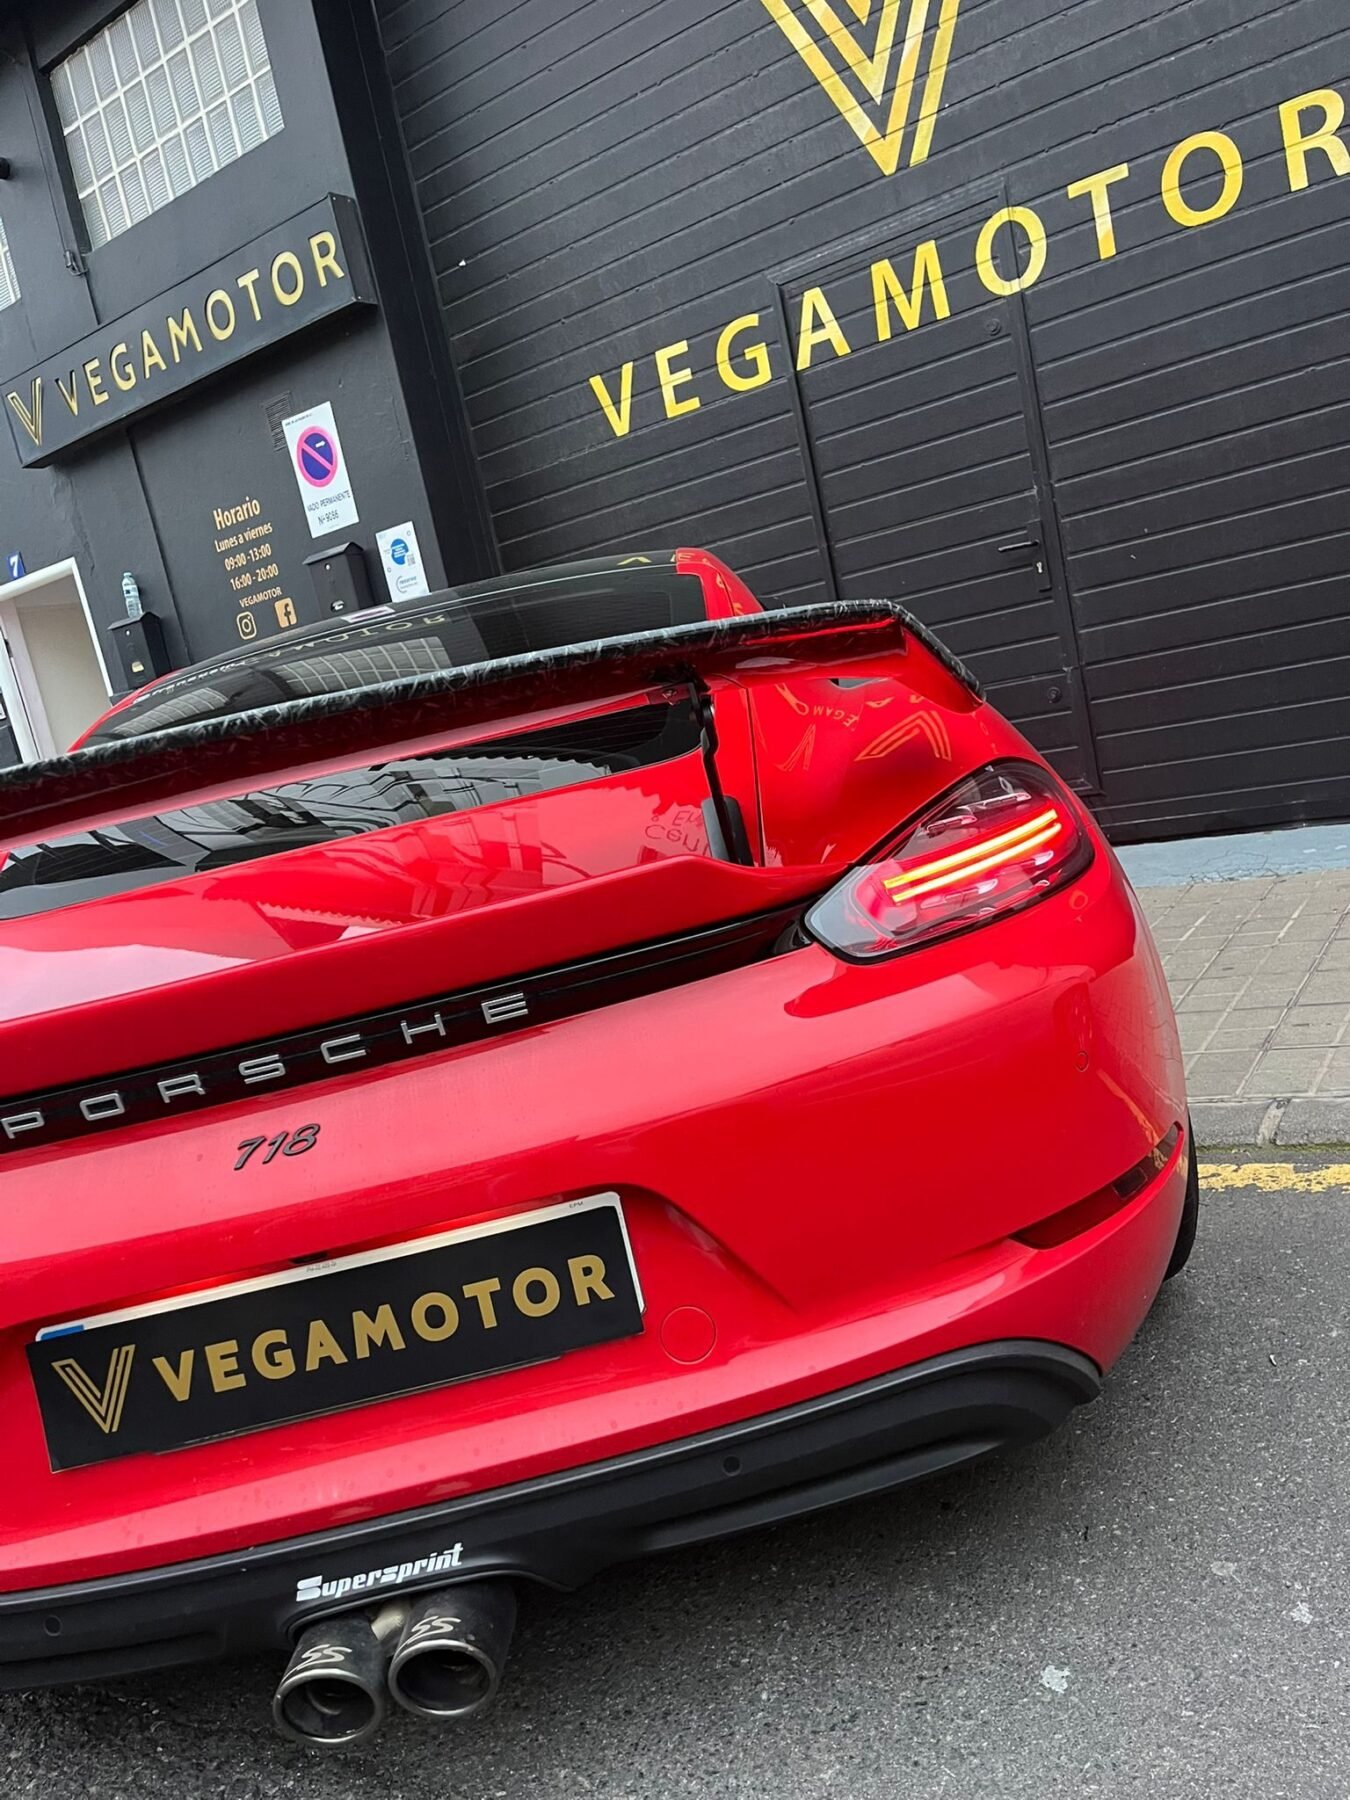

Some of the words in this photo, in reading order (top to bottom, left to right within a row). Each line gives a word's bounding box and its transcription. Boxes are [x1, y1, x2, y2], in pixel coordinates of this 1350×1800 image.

[588, 88, 1350, 438] VEGAMOTOR
[54, 230, 345, 417] VEGAMOTOR
[213, 496, 261, 530] Horario
[214, 535, 238, 552] Lunes
[238, 533, 244, 544] a
[243, 522, 273, 542] viernes
[9, 554, 19, 577] 7
[224, 553, 247, 571] 09:00
[230, 572, 252, 590] 16:00
[255, 563, 279, 582] 20:00
[239, 586, 283, 607] VEGAMOTOR
[1, 992, 529, 1139] PORSCHE
[233, 1123, 321, 1171] 718
[151, 1253, 615, 1402] VEGAMOTOR
[296, 1542, 463, 1602] Supersprint
